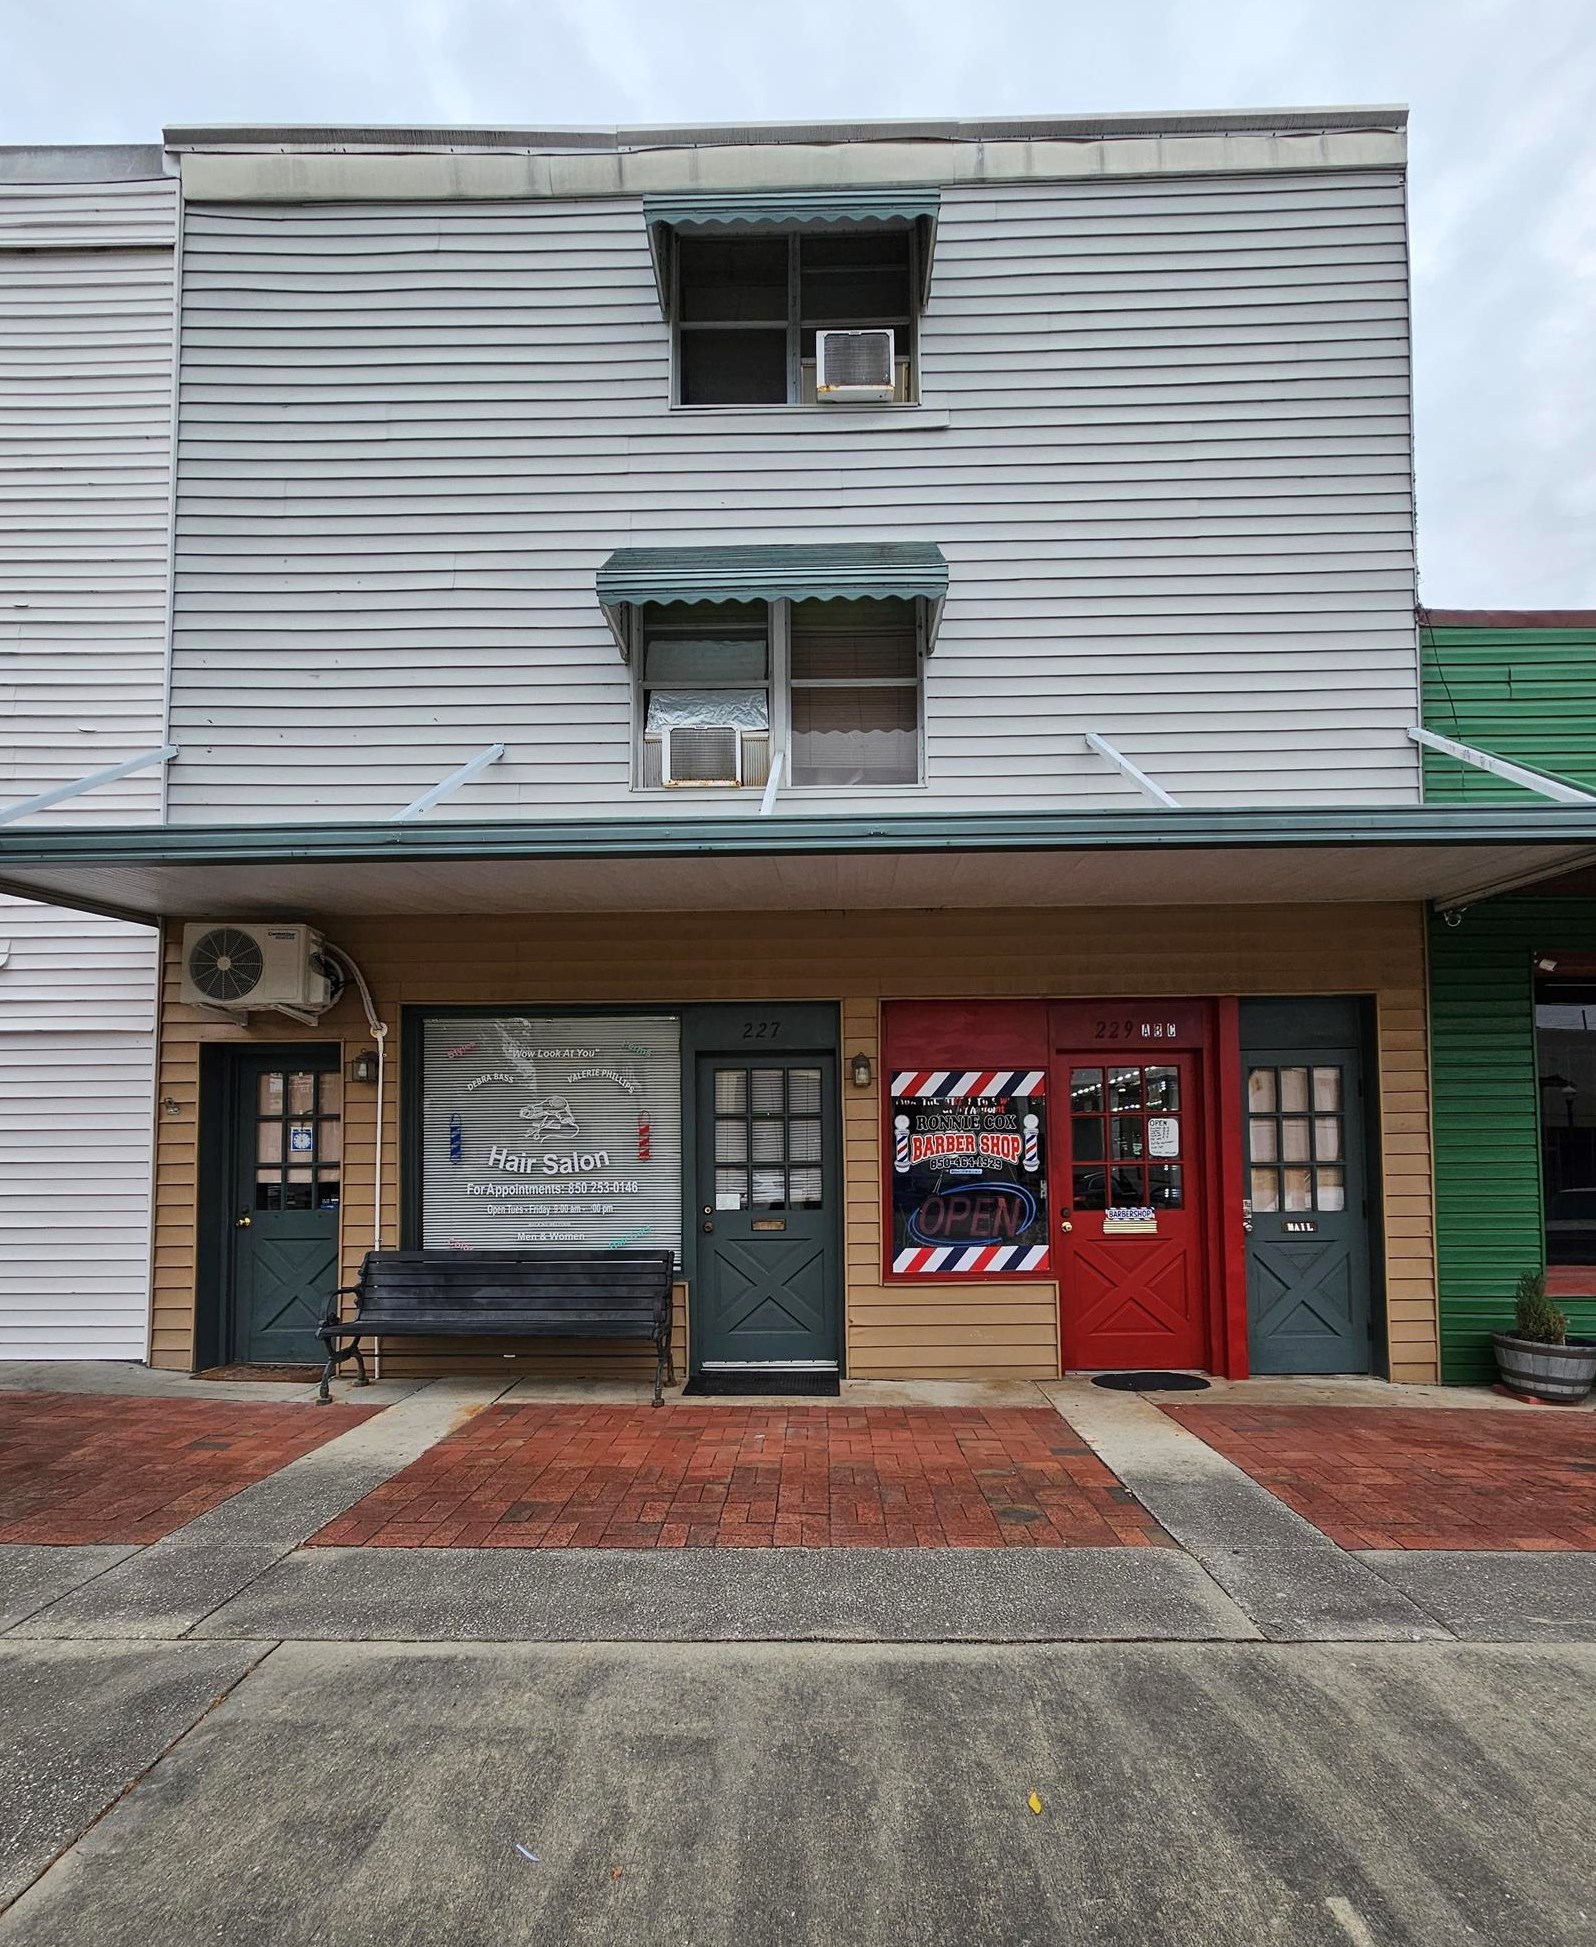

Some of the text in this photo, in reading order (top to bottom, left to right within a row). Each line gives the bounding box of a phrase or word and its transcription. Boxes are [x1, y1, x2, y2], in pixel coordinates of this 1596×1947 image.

[742, 1021, 781, 1039] 227
[1094, 1021, 1134, 1039] 229
[537, 1048, 561, 1058] Look
[563, 1048, 575, 1058] At
[467, 1073, 514, 1091] DEBRA BASS
[567, 1069, 635, 1094] VALERIE PHILLIPS
[916, 1114, 1017, 1130] RONNIE COX
[1149, 1119, 1168, 1127] OPEN
[911, 1133, 1022, 1165] BARBER SHOP
[488, 1145, 610, 1175] Hair Salon
[929, 1156, 1003, 1170] 850-464-1929
[467, 1180, 638, 1198] For Appointments: 850 253-0146
[487, 1204, 505, 1217] Open
[919, 1195, 1021, 1236] OPEN
[1108, 1210, 1151, 1218] BARBERSHOP
[1286, 1222, 1314, 1232] MAIL
[517, 1232, 537, 1241] Men
[549, 1232, 585, 1241] Women
